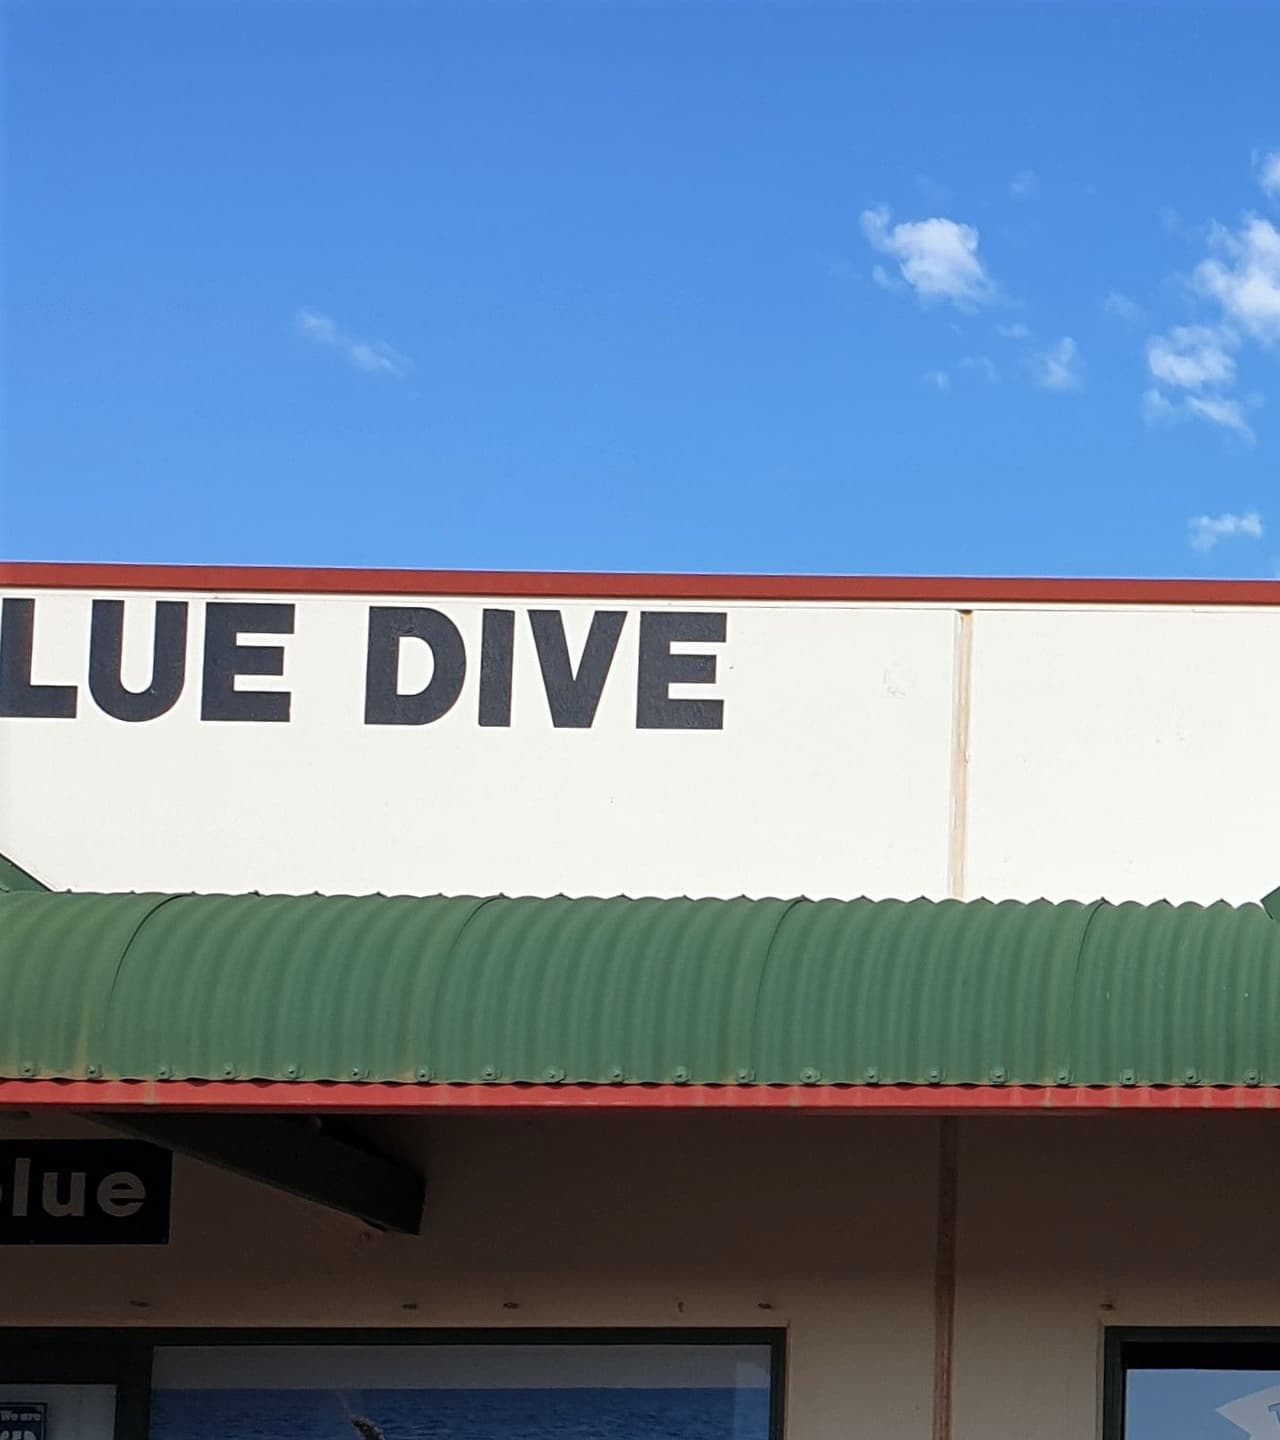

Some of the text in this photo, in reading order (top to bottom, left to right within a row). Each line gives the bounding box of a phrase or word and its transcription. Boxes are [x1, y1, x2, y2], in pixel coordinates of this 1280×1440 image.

[0, 598, 728, 730] LUE DIVE
[0, 1158, 146, 1217] lue
